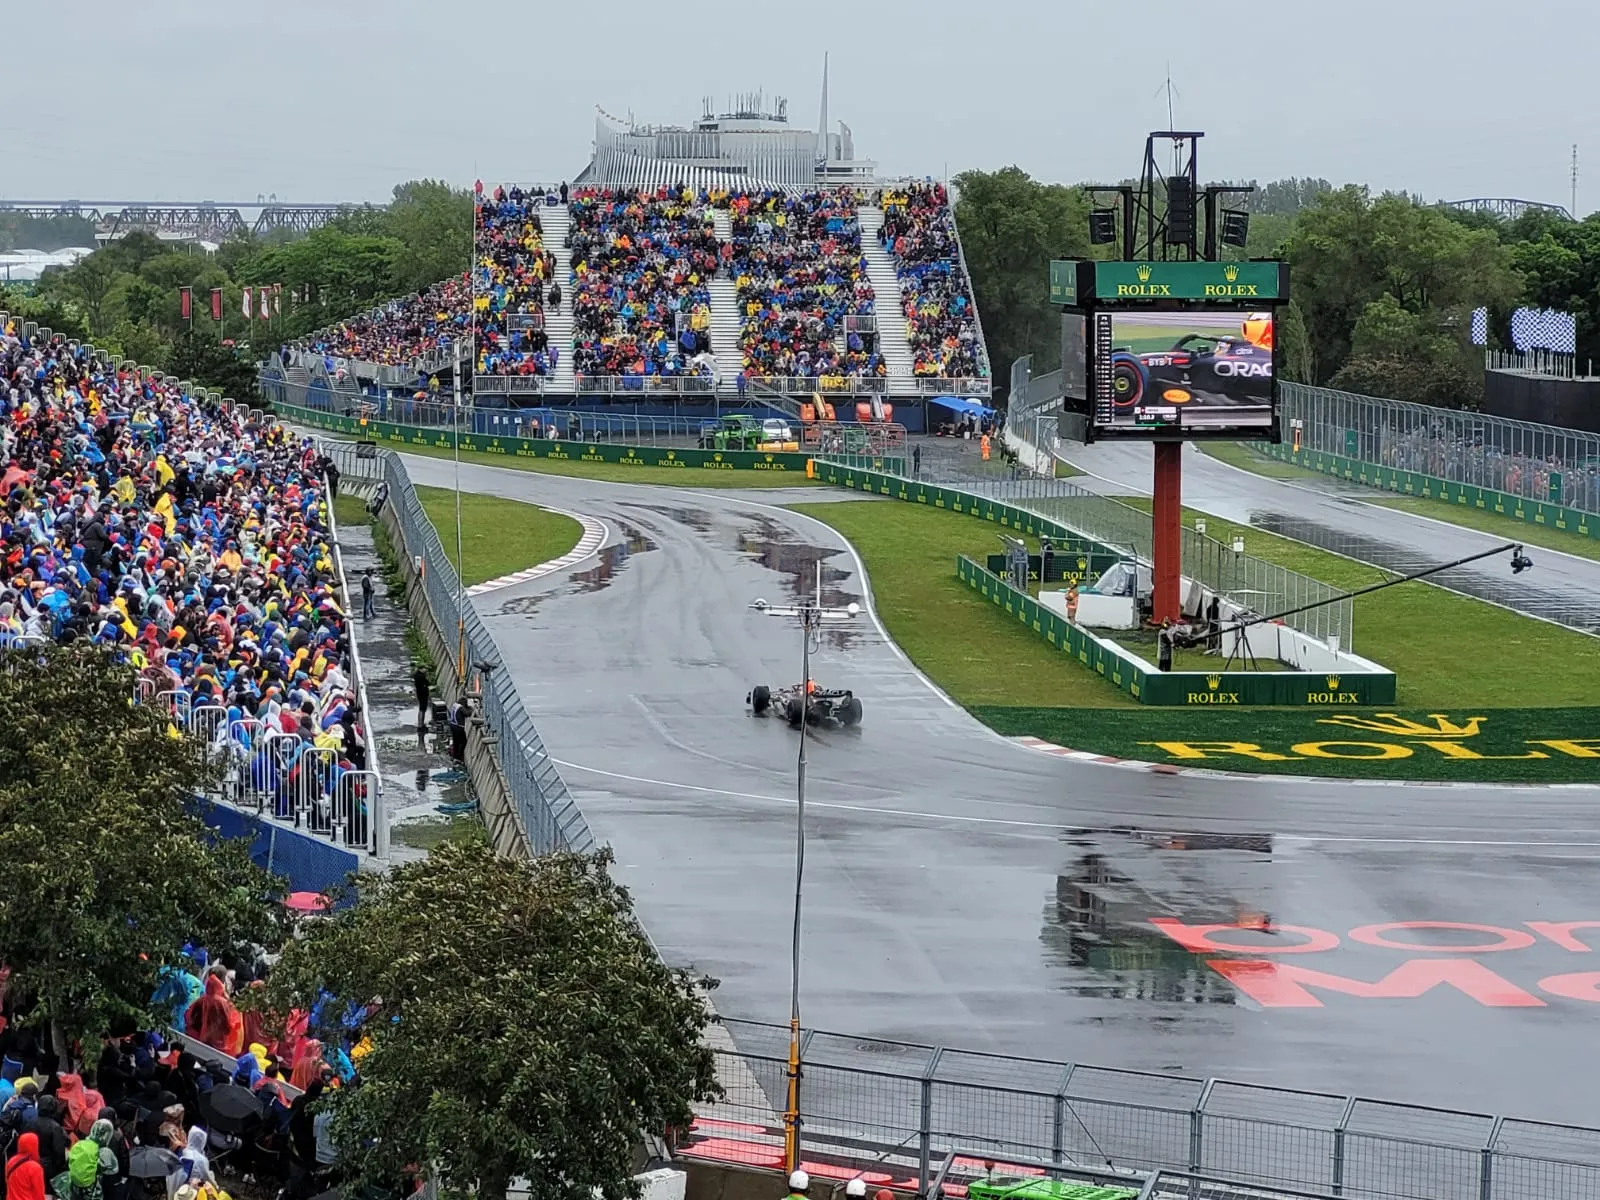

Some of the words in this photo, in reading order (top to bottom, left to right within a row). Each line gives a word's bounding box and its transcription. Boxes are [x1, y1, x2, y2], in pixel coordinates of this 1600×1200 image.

[1117, 284, 1171, 296] ROLEX
[1205, 284, 1258, 296] ROLEX
[619, 457, 644, 465] ROLEX
[658, 459, 686, 468] ROLEX
[703, 461, 733, 469] ROLEX
[754, 462, 786, 470] ROLEX
[1000, 571, 1038, 580] ROX
[1188, 692, 1238, 704] ROLEX
[1307, 692, 1358, 704] ROLEX
